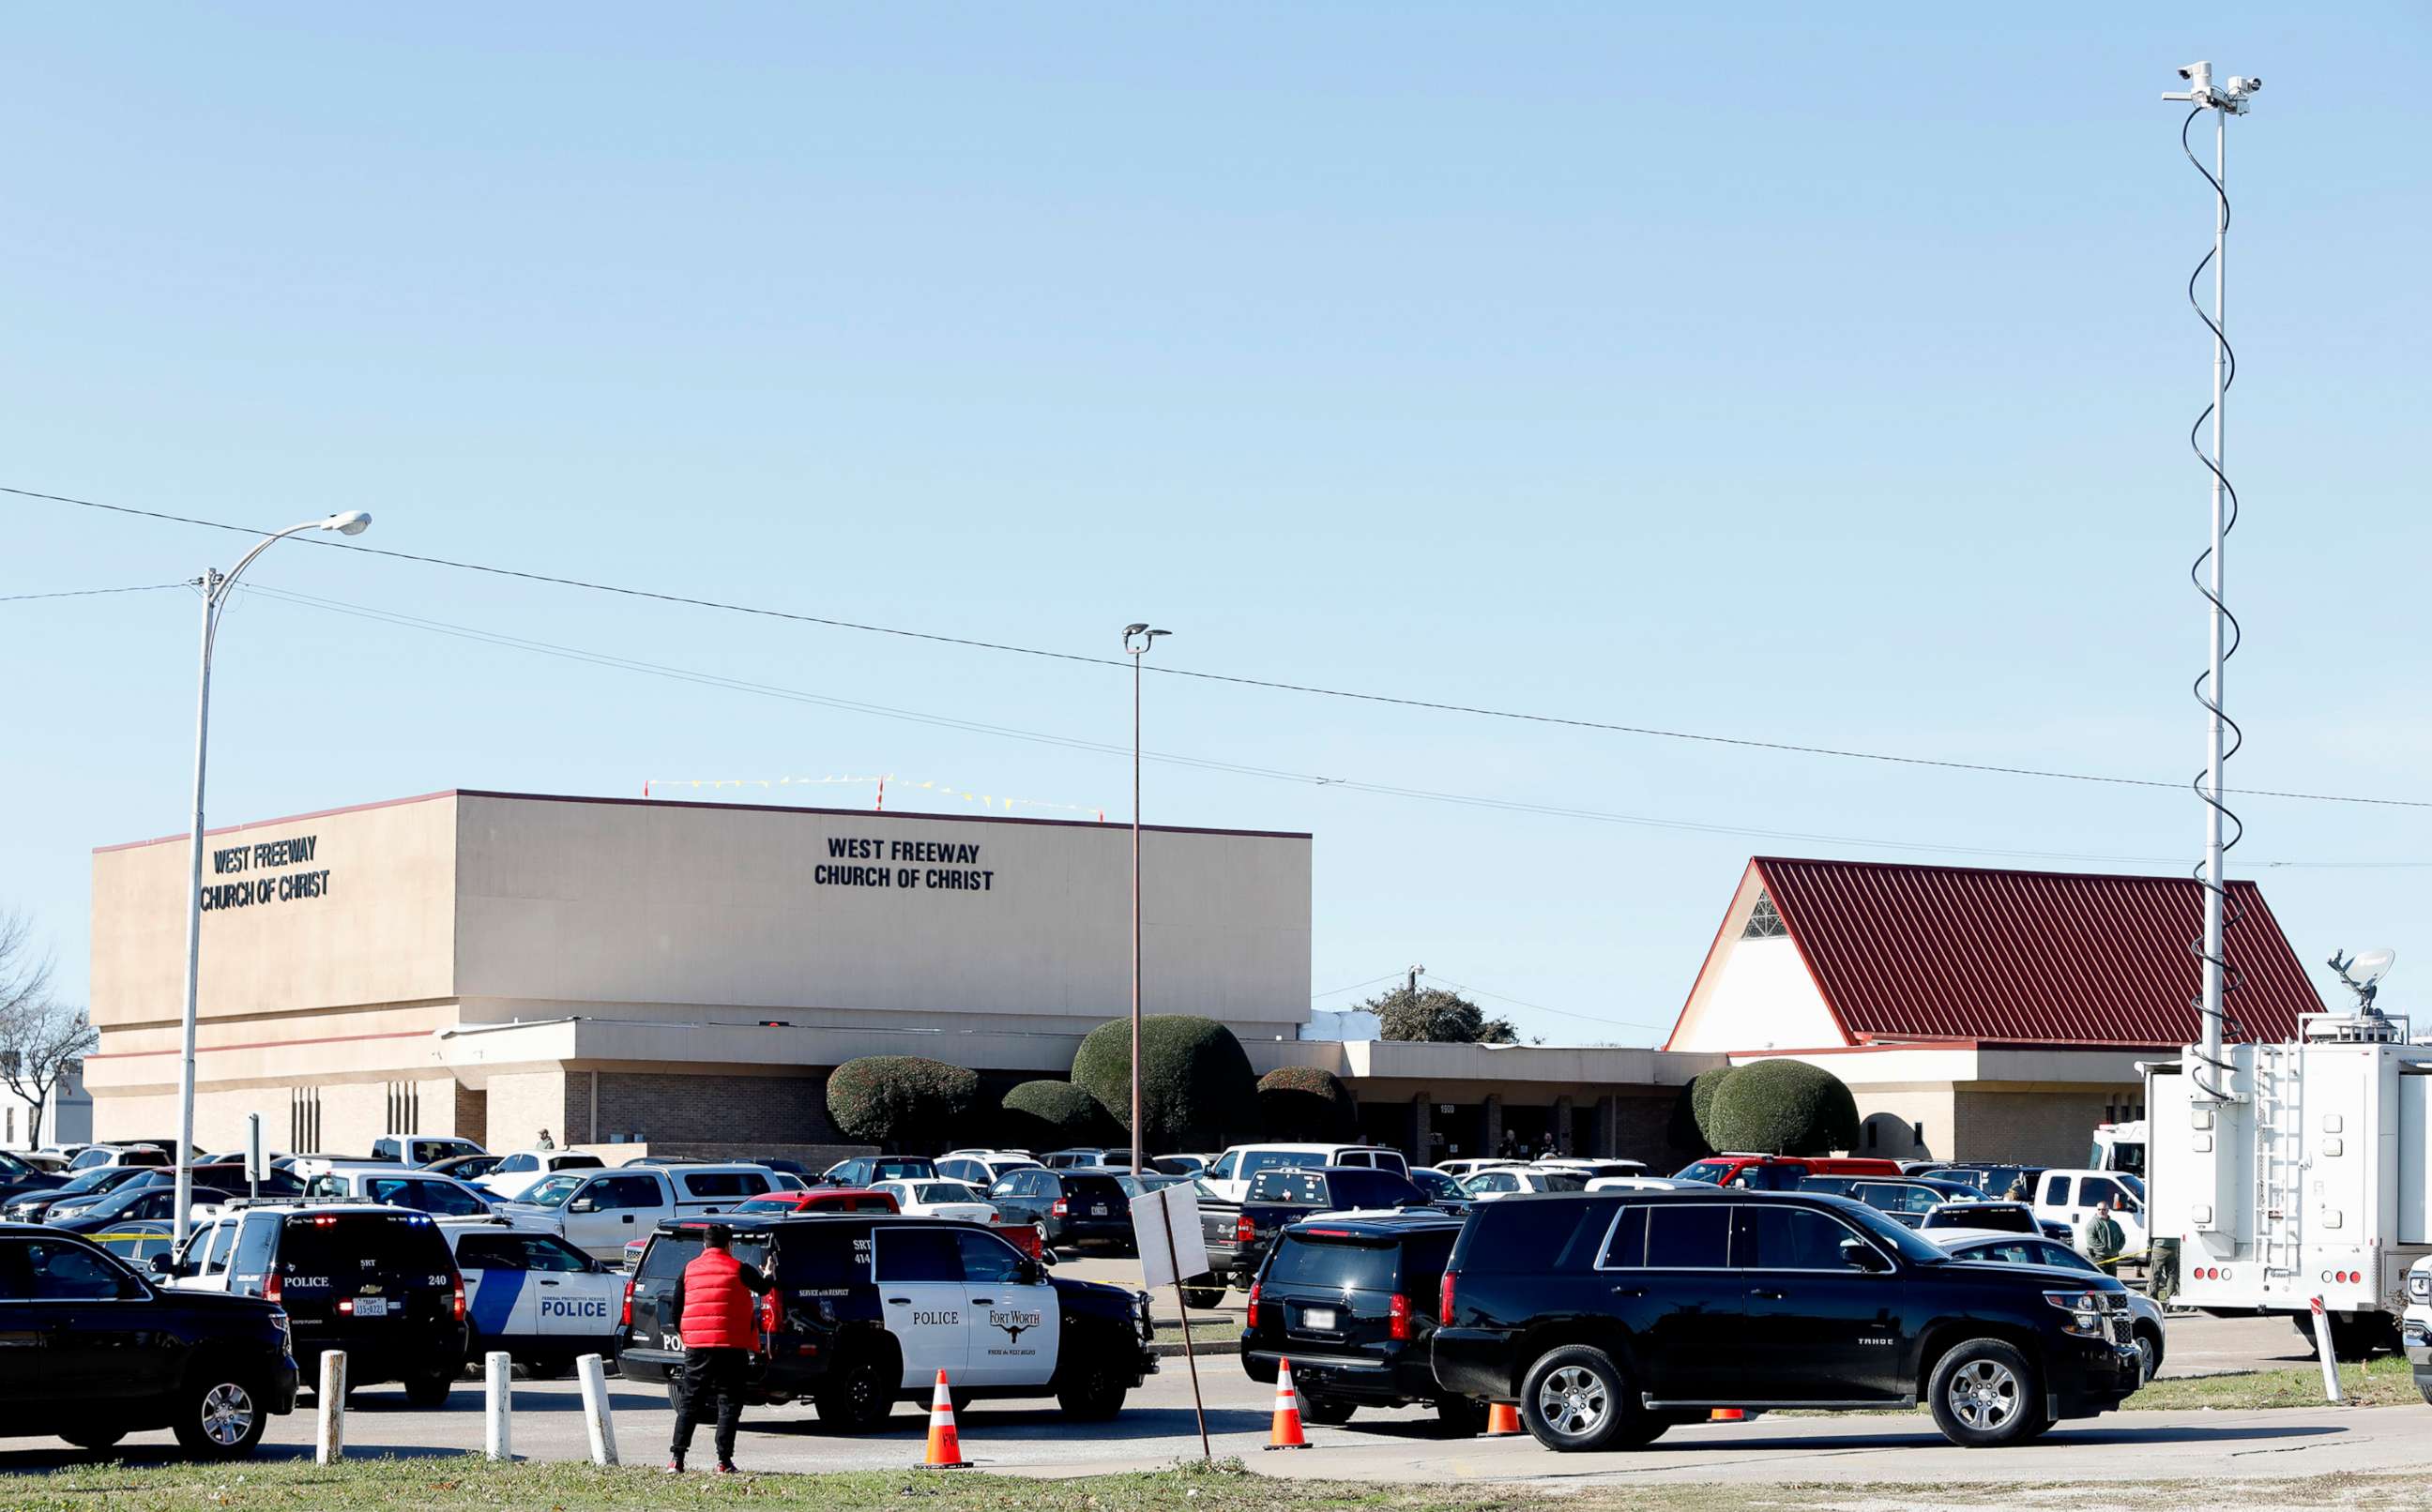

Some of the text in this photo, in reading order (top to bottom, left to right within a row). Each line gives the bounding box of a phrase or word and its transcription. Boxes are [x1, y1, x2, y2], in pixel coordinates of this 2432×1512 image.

[214, 835, 317, 874] WEST FREEWAY
[828, 838, 980, 864] WEST FREEWAY
[814, 865, 994, 890] CHURCH OF CHRIST
[200, 869, 329, 912] CHURCH OF CHRIST
[853, 1239, 872, 1250] SRT
[855, 1254, 871, 1263] 414
[284, 1277, 329, 1288] POLICE
[428, 1275, 447, 1286] 240
[541, 1301, 606, 1317] POLICE
[913, 1311, 959, 1324] POLICE
